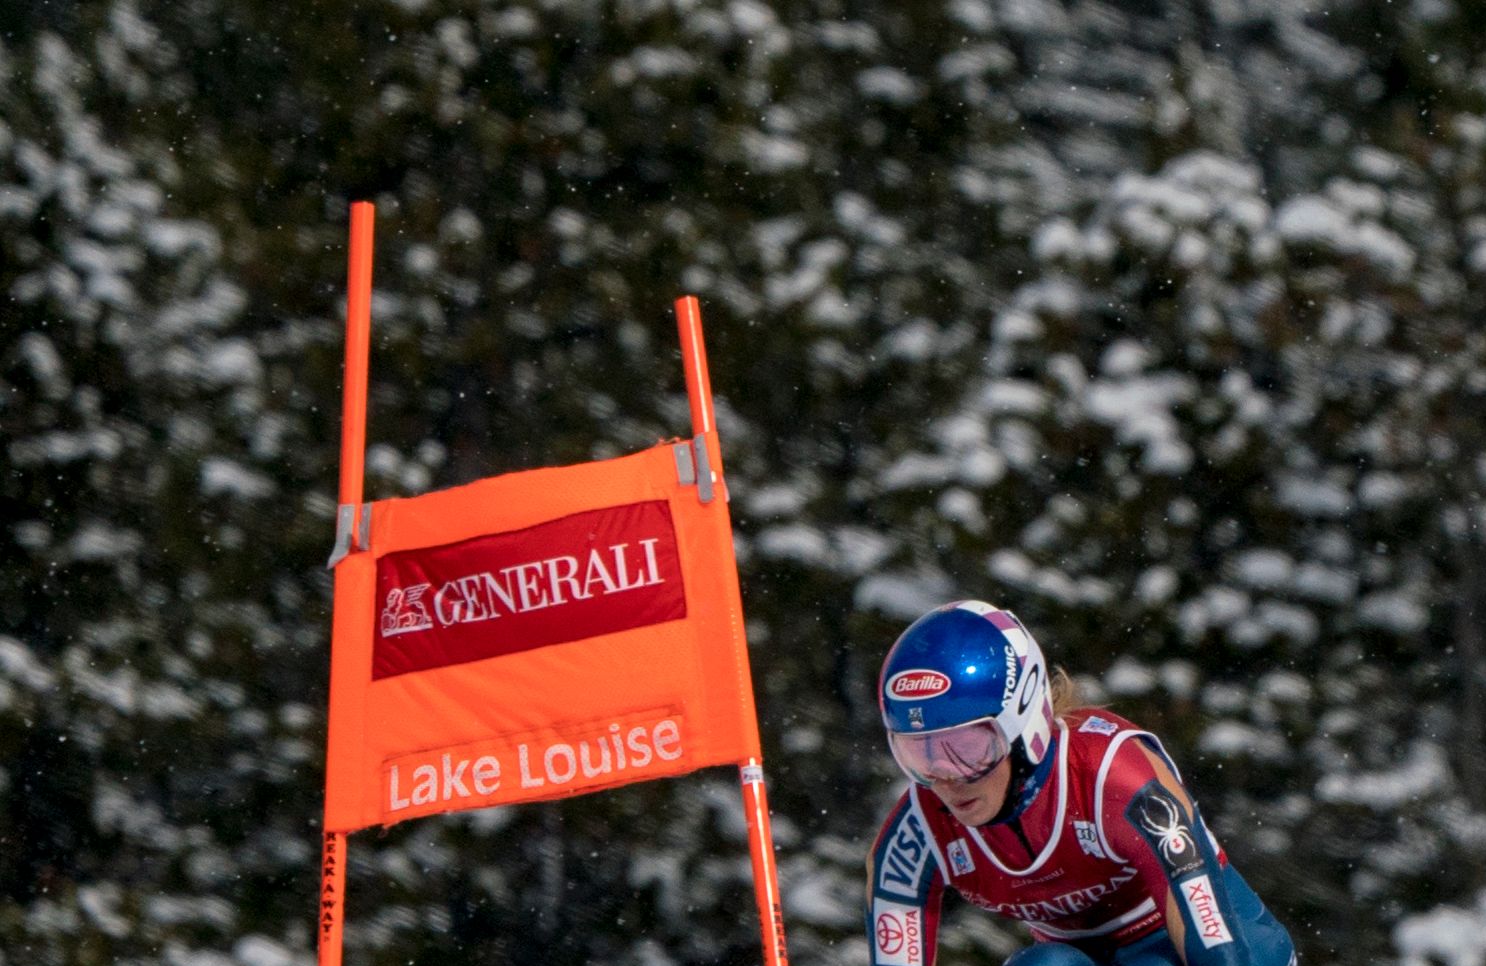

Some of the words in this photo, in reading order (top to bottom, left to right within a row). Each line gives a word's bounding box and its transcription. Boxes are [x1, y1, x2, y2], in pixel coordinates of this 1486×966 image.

[433, 538, 665, 627] GENERALI
[895, 675, 945, 693] Barilla
[1001, 645, 1017, 708] ATOMIC
[389, 752, 502, 812] Lake
[519, 718, 683, 790] Louise
[883, 814, 927, 887] VISA
[905, 909, 919, 964] TOYOTA
